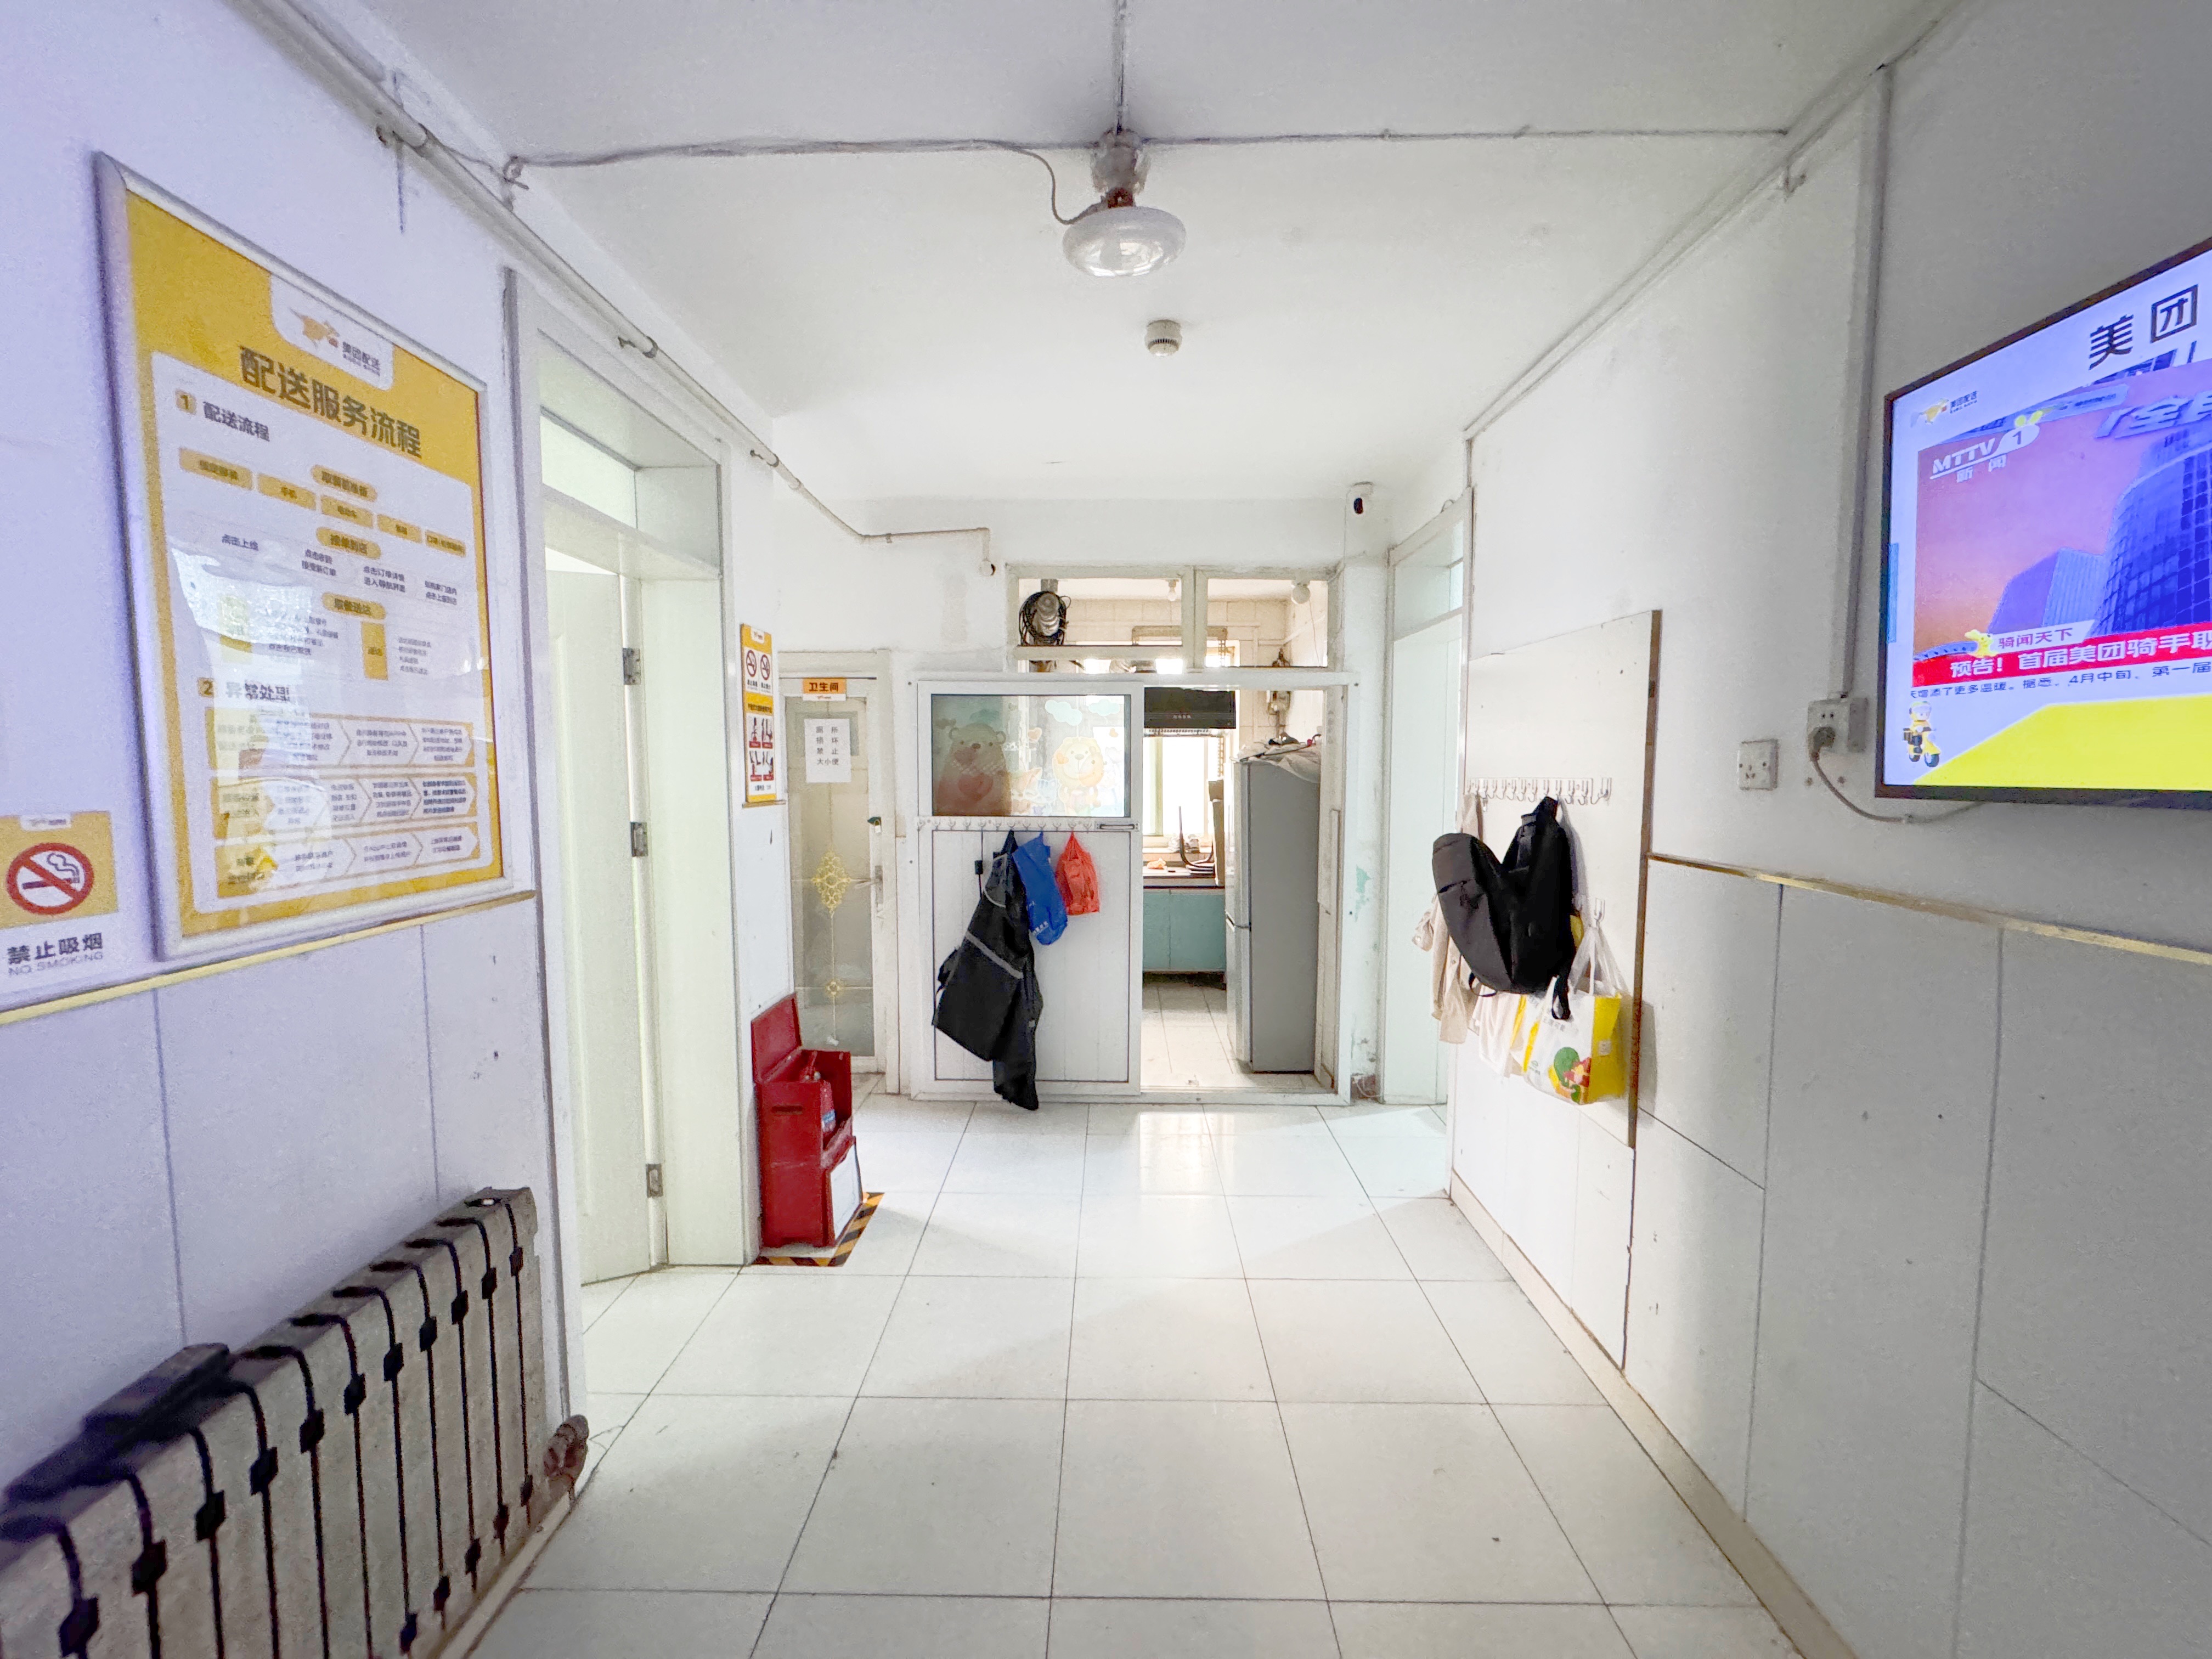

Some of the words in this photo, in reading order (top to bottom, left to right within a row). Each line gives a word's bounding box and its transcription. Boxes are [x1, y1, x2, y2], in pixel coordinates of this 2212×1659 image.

[239, 345, 422, 459] 配送服务流程
[203, 401, 270, 442] 配送流程
[1932, 438, 1996, 474] MTTV
[809, 682, 839, 692] 卫生间
[7, 933, 103, 964] 禁止吸烟
